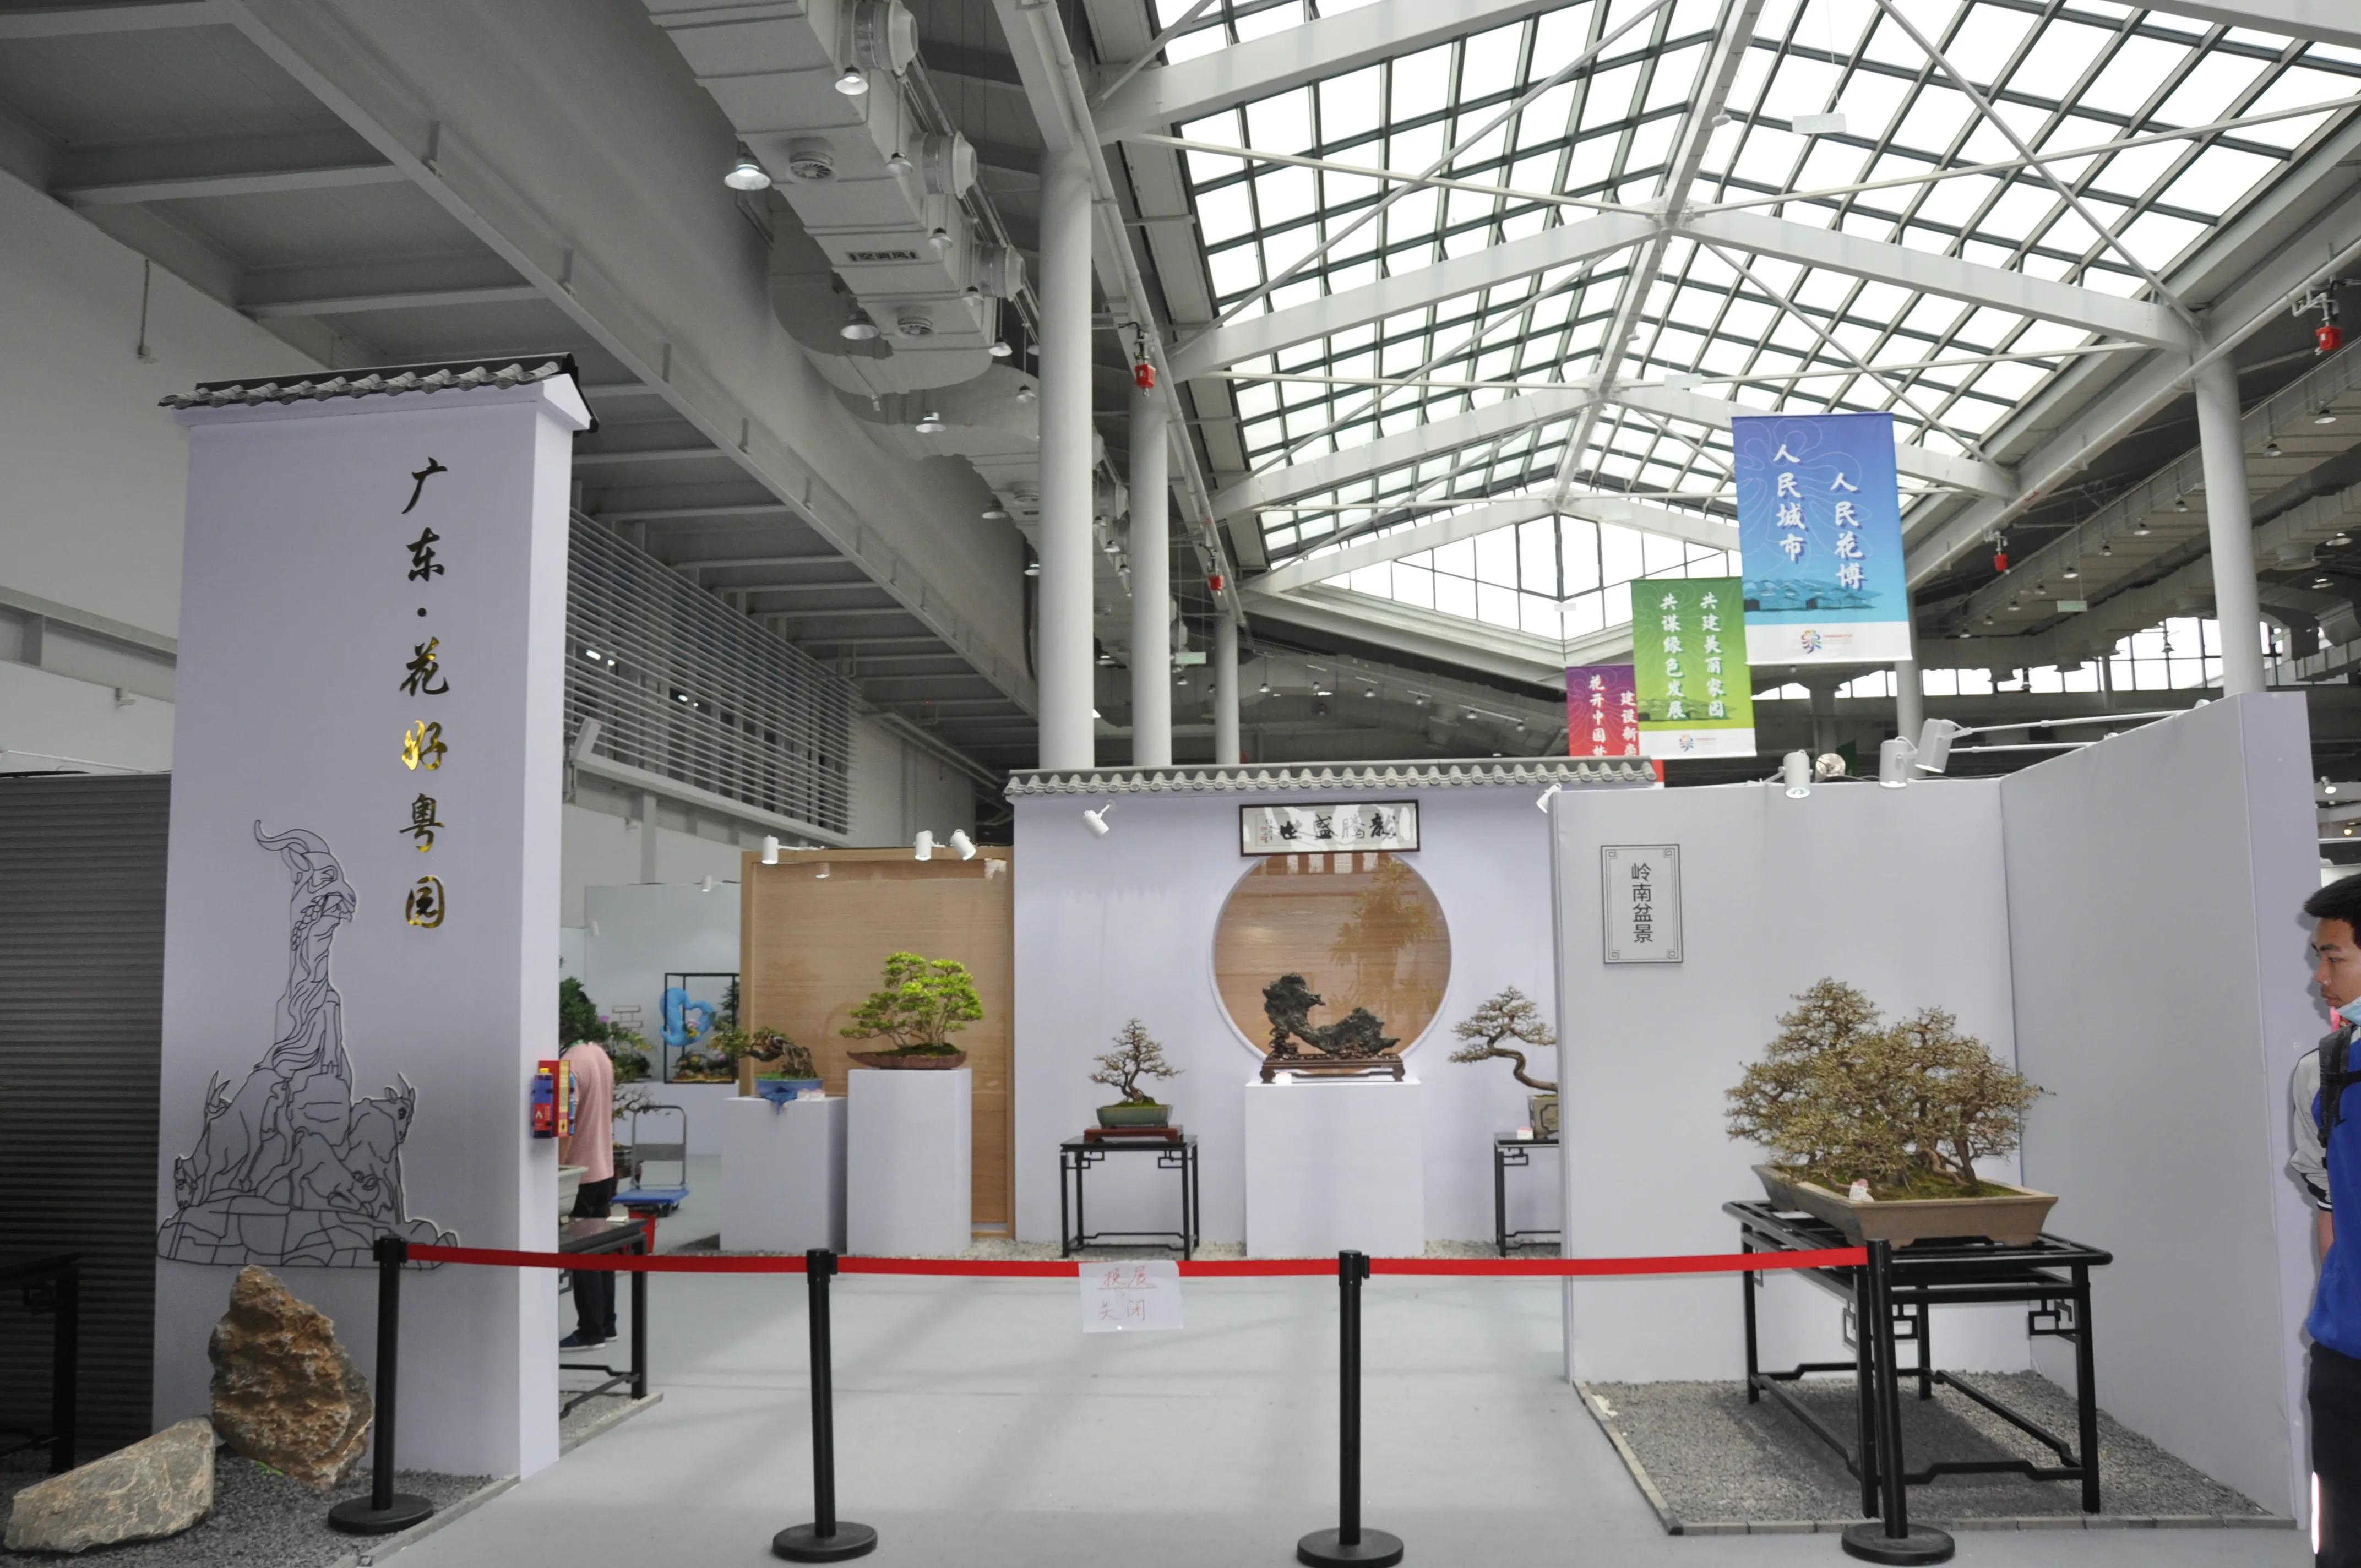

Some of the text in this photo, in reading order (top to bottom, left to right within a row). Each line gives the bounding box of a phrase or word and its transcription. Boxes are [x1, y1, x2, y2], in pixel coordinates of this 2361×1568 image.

[1772, 444, 1806, 562] 人民城市
[1830, 472, 1865, 590] 人民花博
[1660, 592, 1687, 720] 共谋绿色发展
[1700, 591, 1726, 718] 共建美丽家园
[1631, 862, 1653, 943] 岭南盆景
[1099, 1299, 1146, 1321] 关闭
